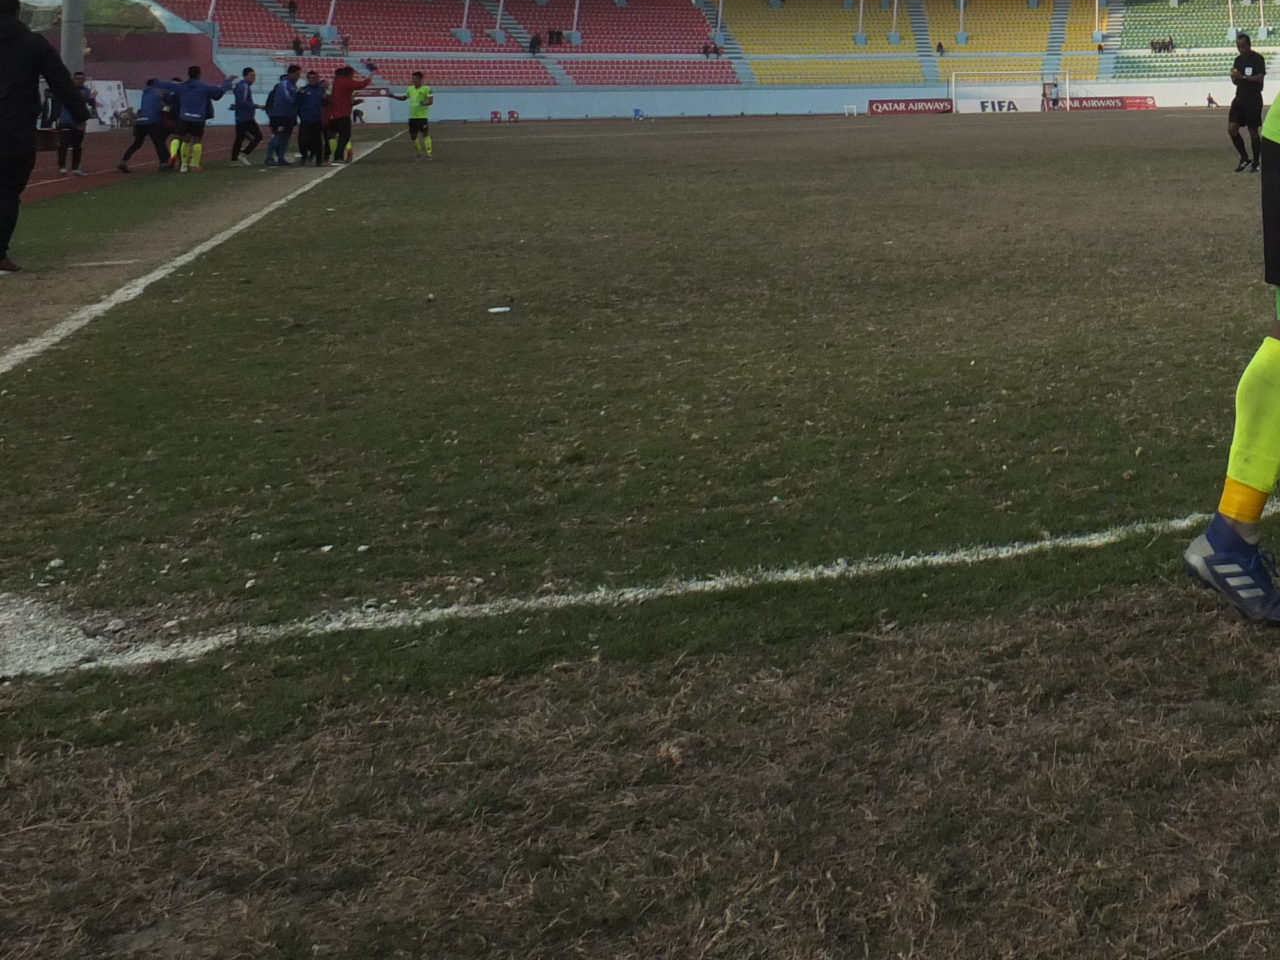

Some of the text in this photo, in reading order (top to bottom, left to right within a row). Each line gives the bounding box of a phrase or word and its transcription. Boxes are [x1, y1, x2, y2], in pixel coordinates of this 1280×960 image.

[873, 101, 951, 112] QATAR AIRWAYS
[980, 100, 1018, 112] FIFA
[1082, 99, 1122, 108] AIRWAYS
